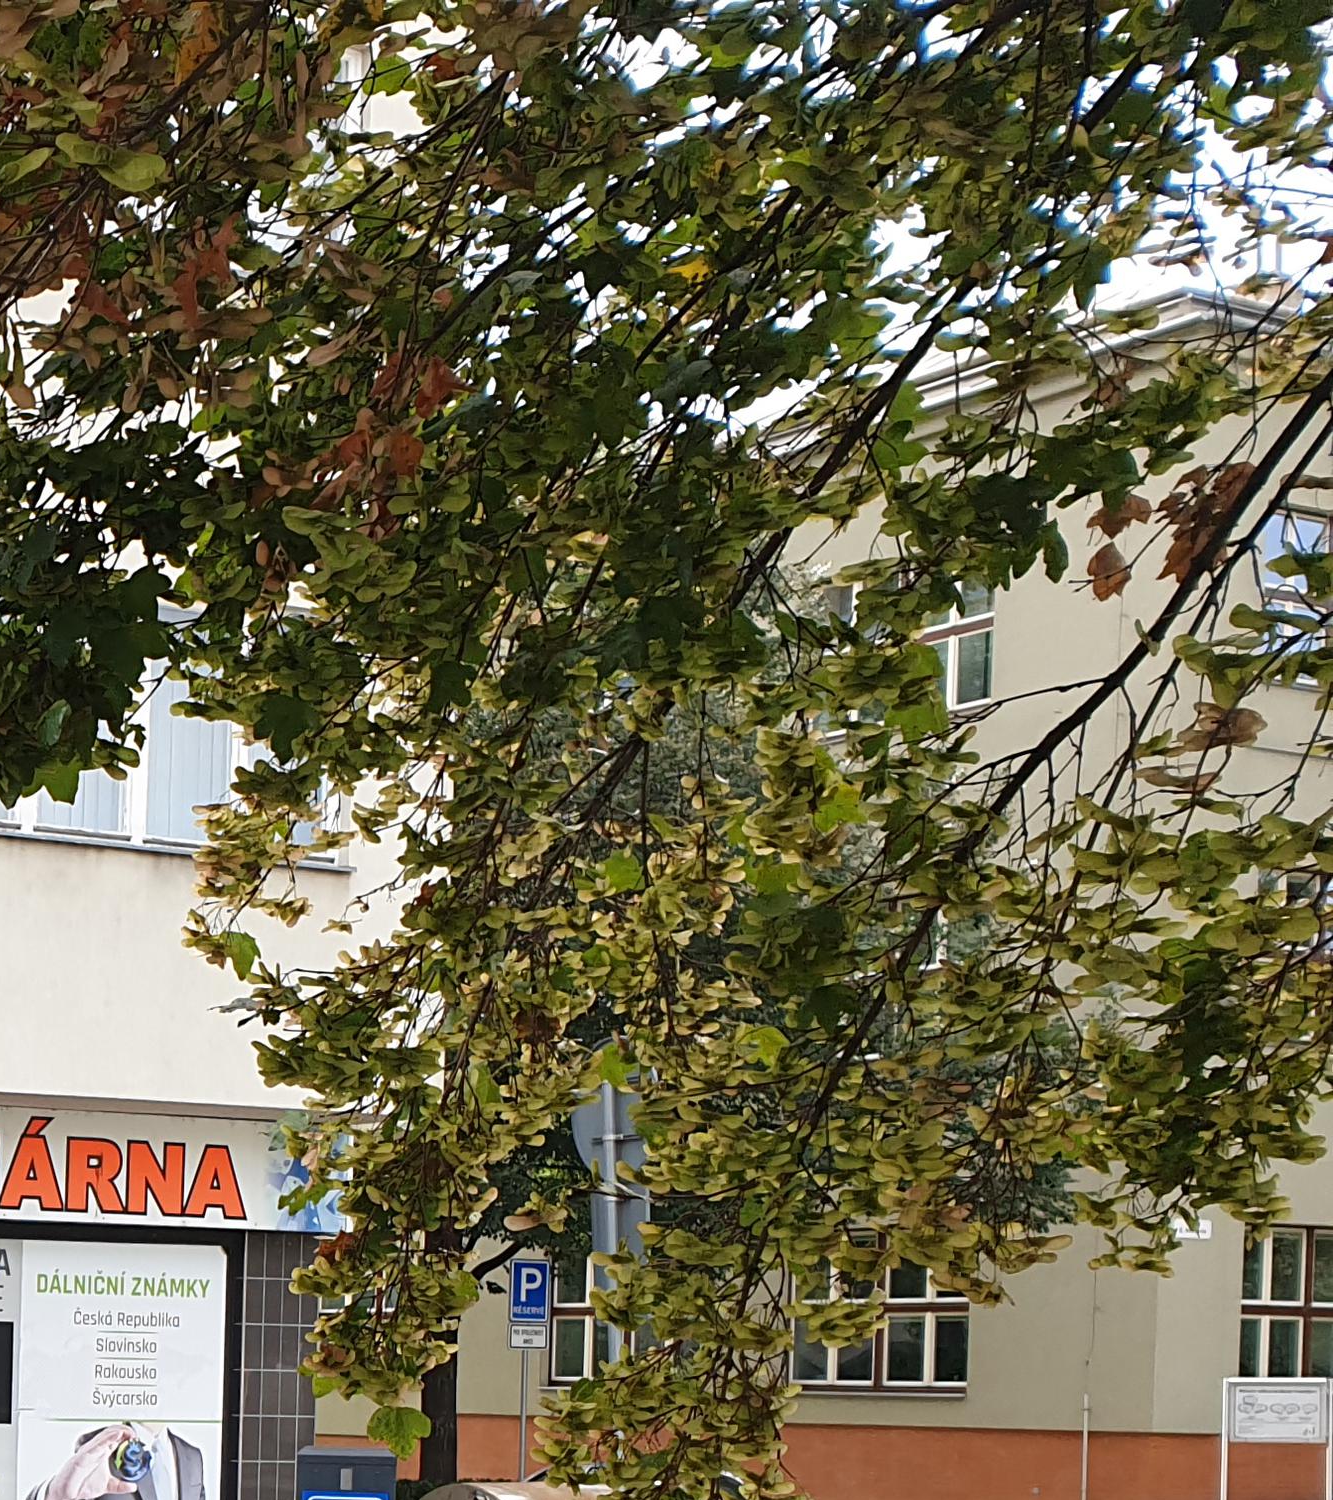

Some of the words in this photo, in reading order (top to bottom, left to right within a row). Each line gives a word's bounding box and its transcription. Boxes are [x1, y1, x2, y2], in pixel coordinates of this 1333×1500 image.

[36, 1268, 126, 1296] DÁLNIČNÍ
[131, 1272, 211, 1298] ZNÁMKY
[520, 1267, 543, 1302] P
[73, 1307, 113, 1326] Česká
[117, 1311, 181, 1329] Republika
[95, 1338, 158, 1354] Slovinsko
[94, 1364, 158, 1380] Rakousko
[92, 1387, 159, 1408] Švýcarsko
